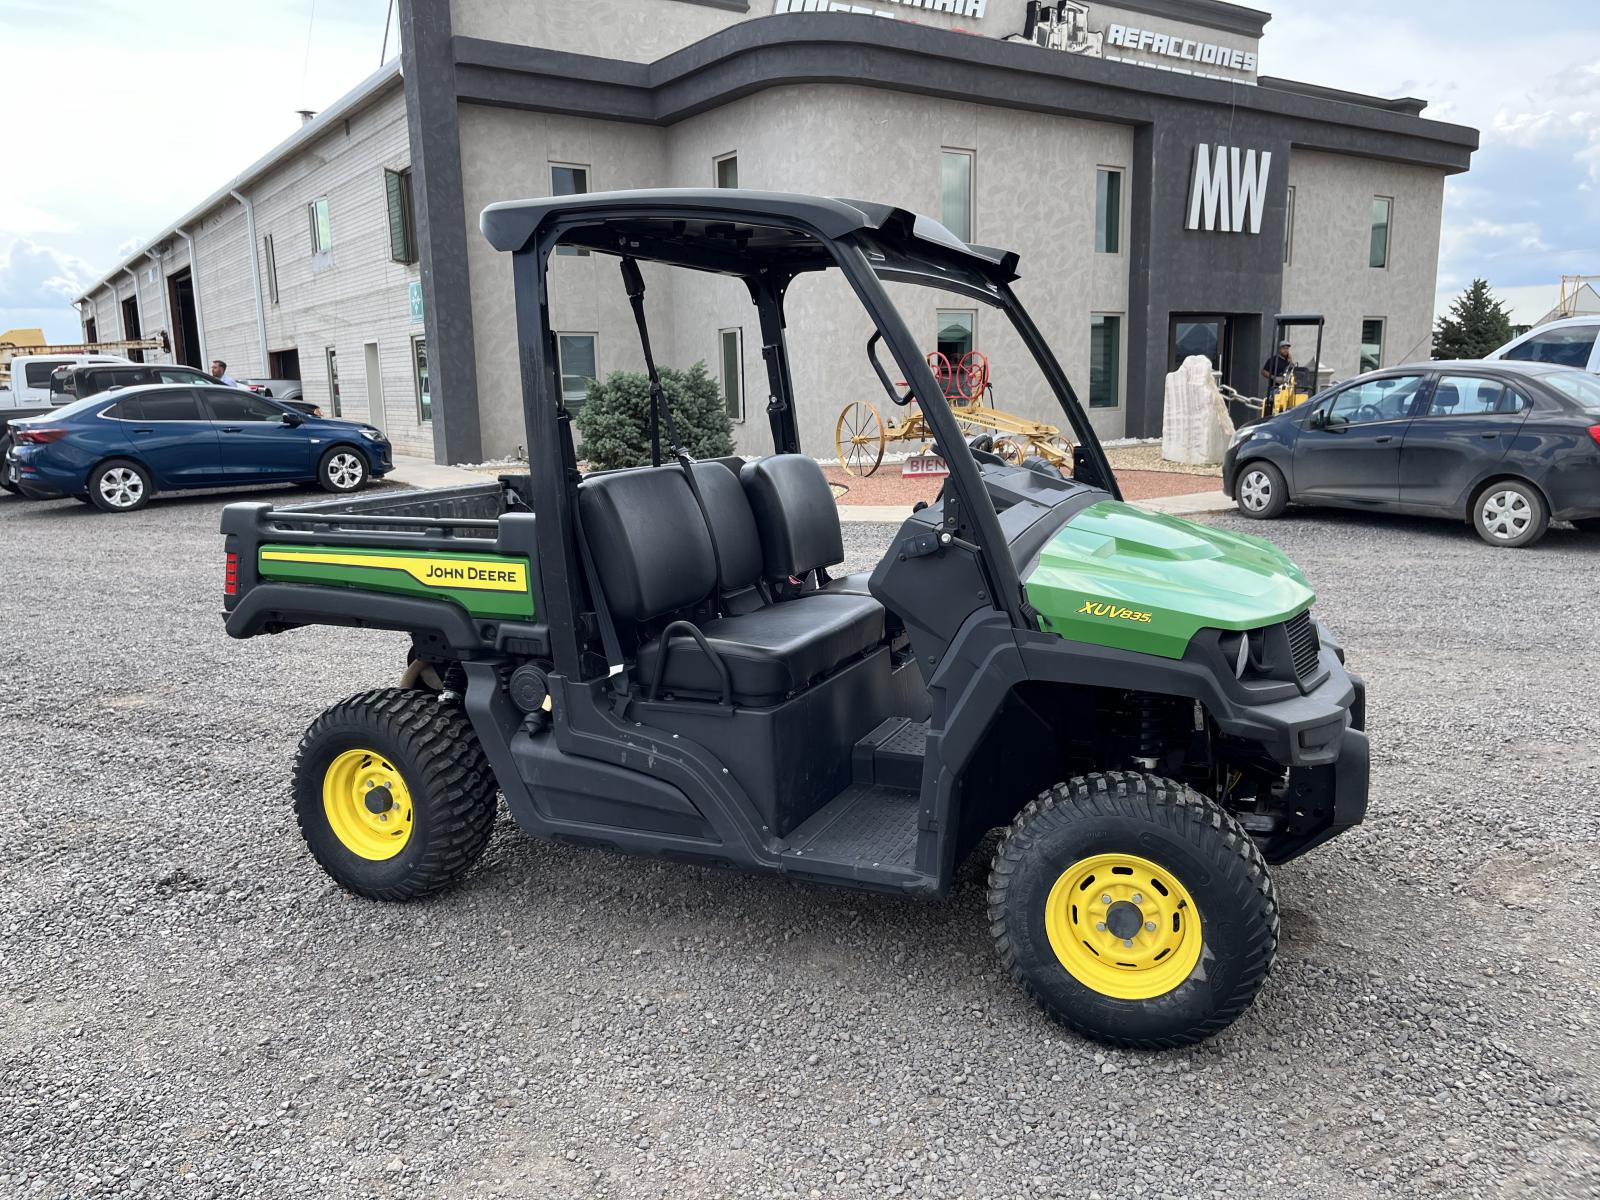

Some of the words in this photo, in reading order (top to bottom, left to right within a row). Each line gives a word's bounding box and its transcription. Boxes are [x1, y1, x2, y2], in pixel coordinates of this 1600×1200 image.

[1107, 23, 1258, 71] REFACCIONES
[1186, 143, 1272, 234] MW
[910, 458, 946, 472] BIEN
[427, 565, 464, 579] JOHN
[467, 567, 517, 582] DEERE
